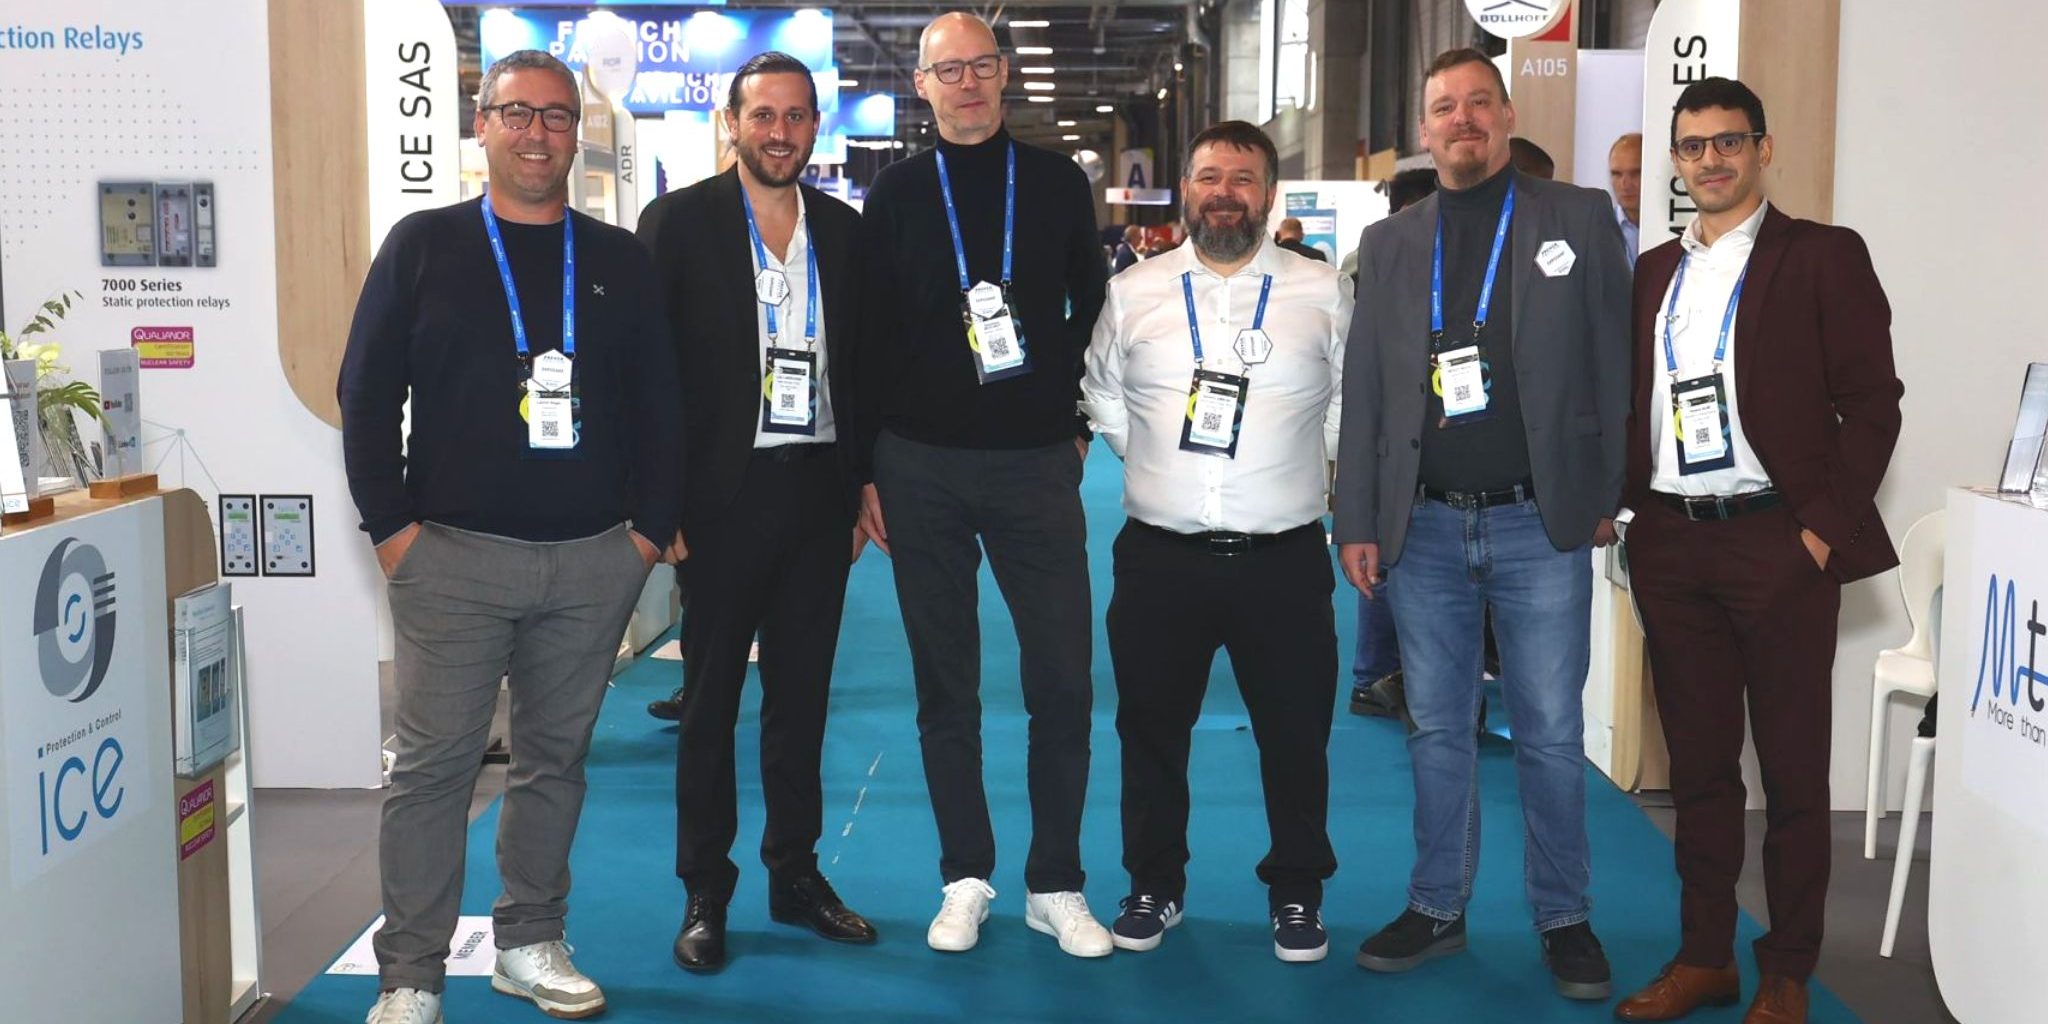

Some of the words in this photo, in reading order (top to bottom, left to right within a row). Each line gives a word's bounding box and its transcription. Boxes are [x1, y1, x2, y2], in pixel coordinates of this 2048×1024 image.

[64, 24, 143, 55] Relays
[398, 41, 431, 118] SAS
[1520, 58, 1568, 76] A105
[400, 135, 433, 194] ICE
[621, 145, 633, 184] ADR
[1128, 163, 1146, 188] A
[102, 278, 136, 292] 7000
[140, 278, 183, 292] Series
[102, 296, 133, 308] Static
[137, 296, 194, 310] protection
[197, 296, 231, 311] relays
[46, 728, 86, 755] Protection
[88, 722, 94, 734] &
[95, 708, 122, 730] Control
[1987, 699, 2014, 730] More
[2021, 715, 2047, 748] than
[453, 931, 488, 959] MEMBER
